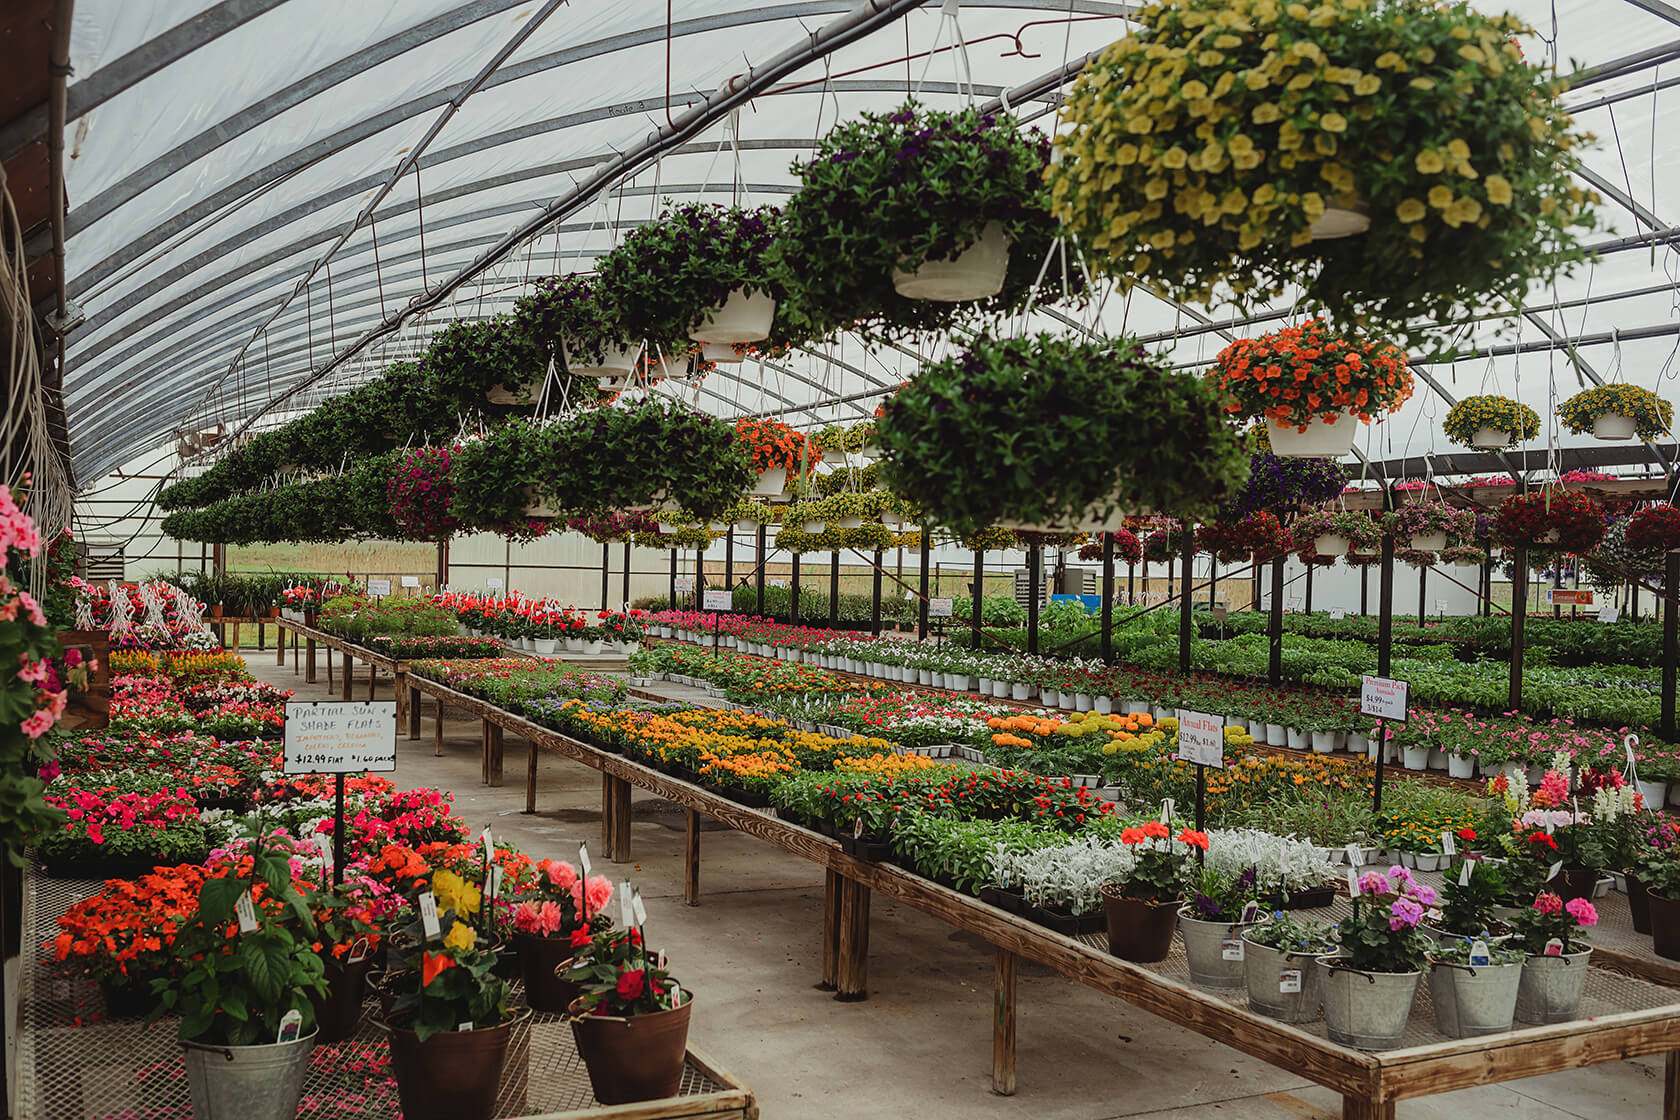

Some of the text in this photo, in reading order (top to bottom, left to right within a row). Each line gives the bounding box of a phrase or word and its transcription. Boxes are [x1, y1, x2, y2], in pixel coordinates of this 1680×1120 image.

[293, 707, 344, 719] PARTIAL
[352, 706, 375, 715] SUN
[301, 719, 382, 731] SHADE FLATS
[295, 754, 326, 764] $12.99
